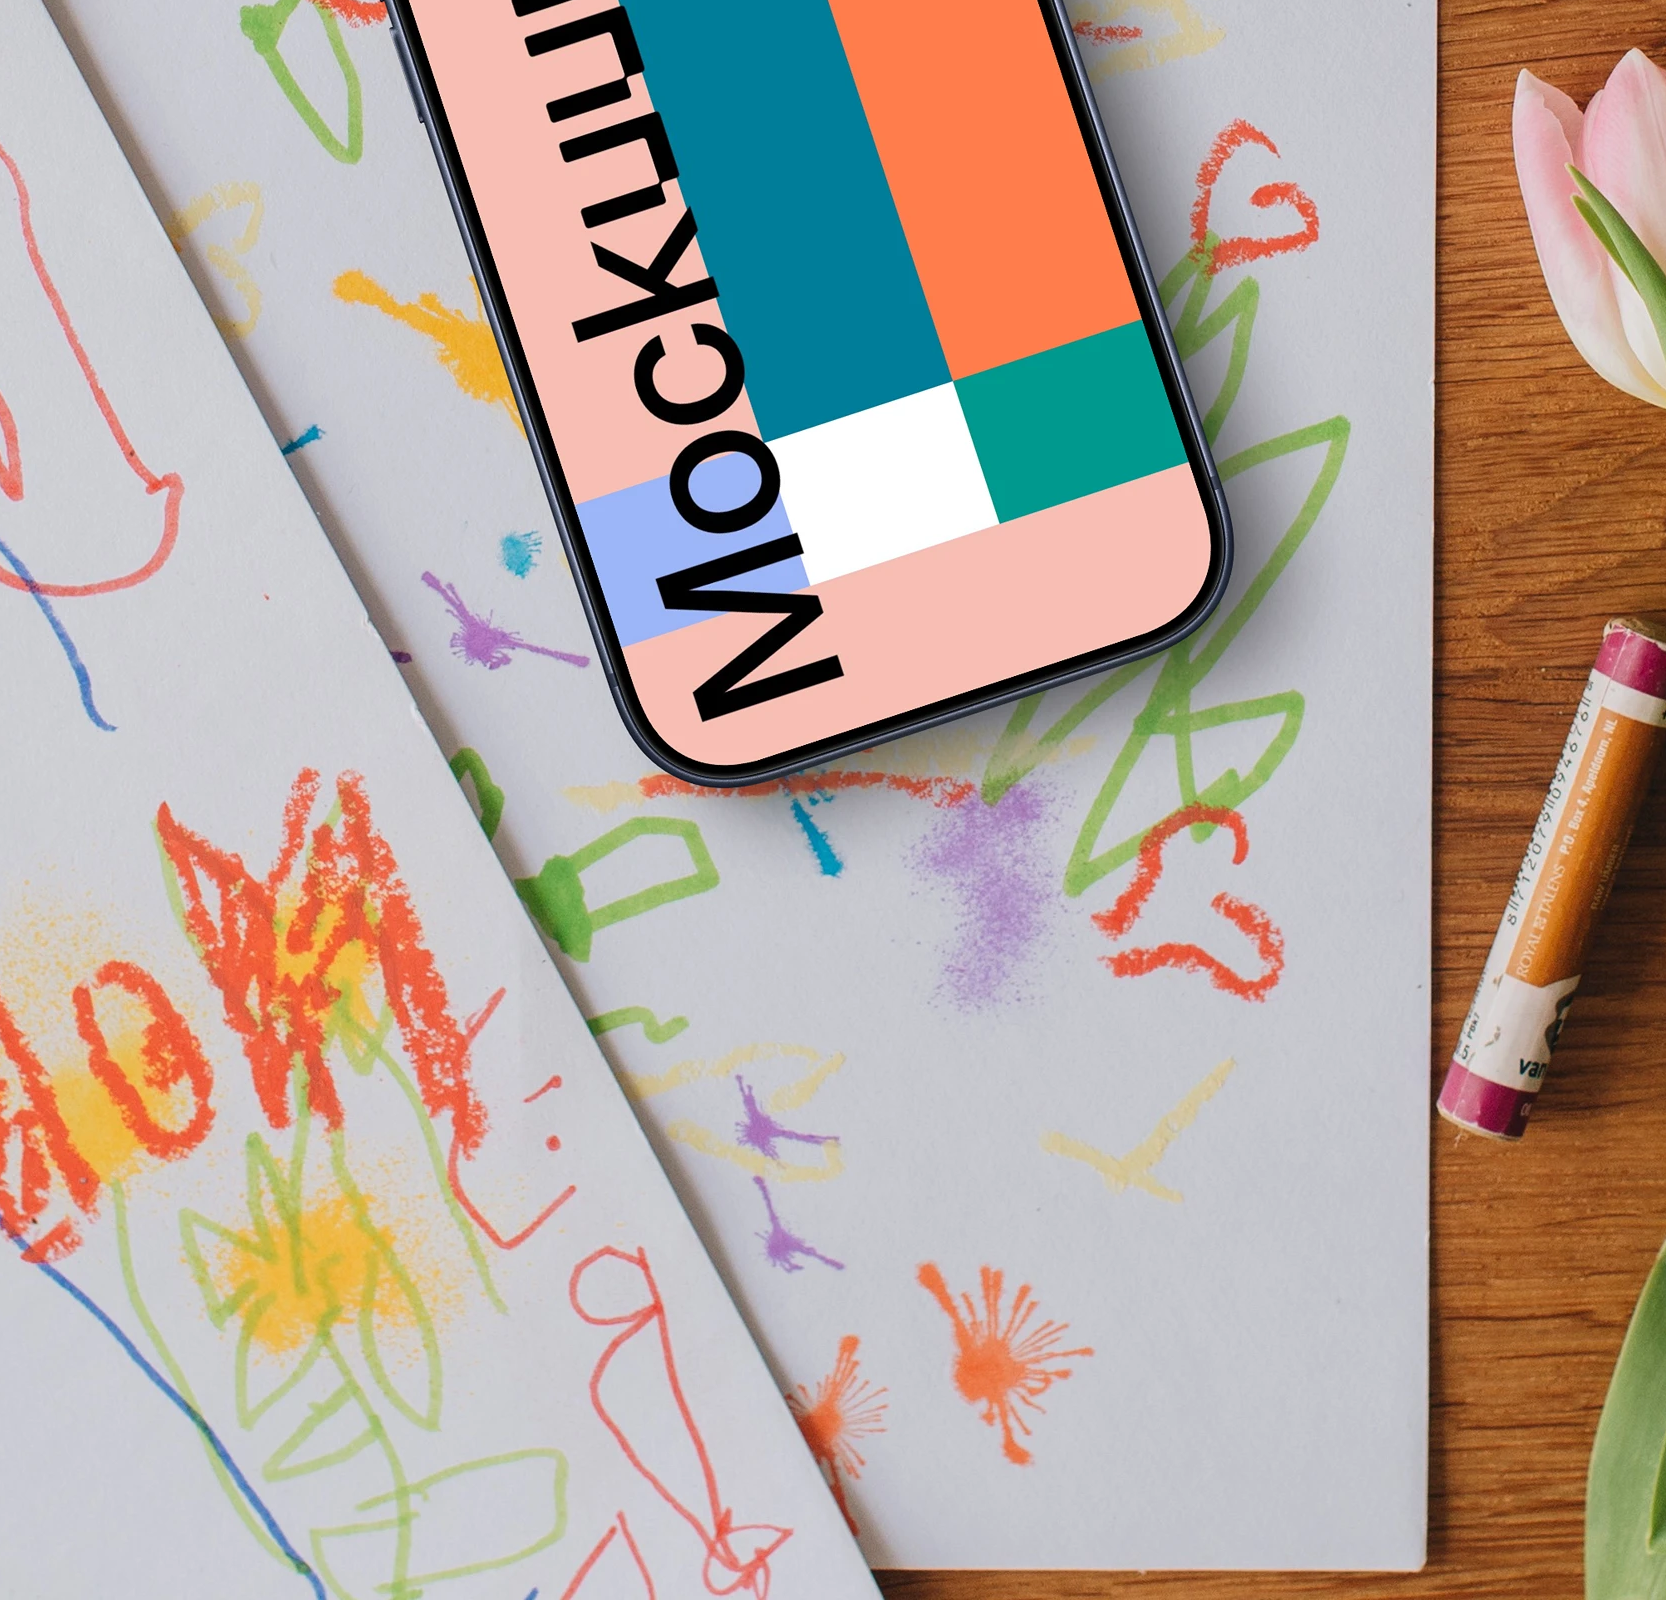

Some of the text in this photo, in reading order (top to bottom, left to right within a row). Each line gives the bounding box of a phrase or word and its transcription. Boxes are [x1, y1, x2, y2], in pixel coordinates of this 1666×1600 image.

[1603, 716, 1618, 734] NL
[1581, 734, 1613, 795] Apeldoorn,
[1568, 807, 1586, 830] Box
[1559, 830, 1578, 855] P.O.
[1538, 862, 1566, 916] TALENS
[1516, 931, 1542, 978] ROYAL
